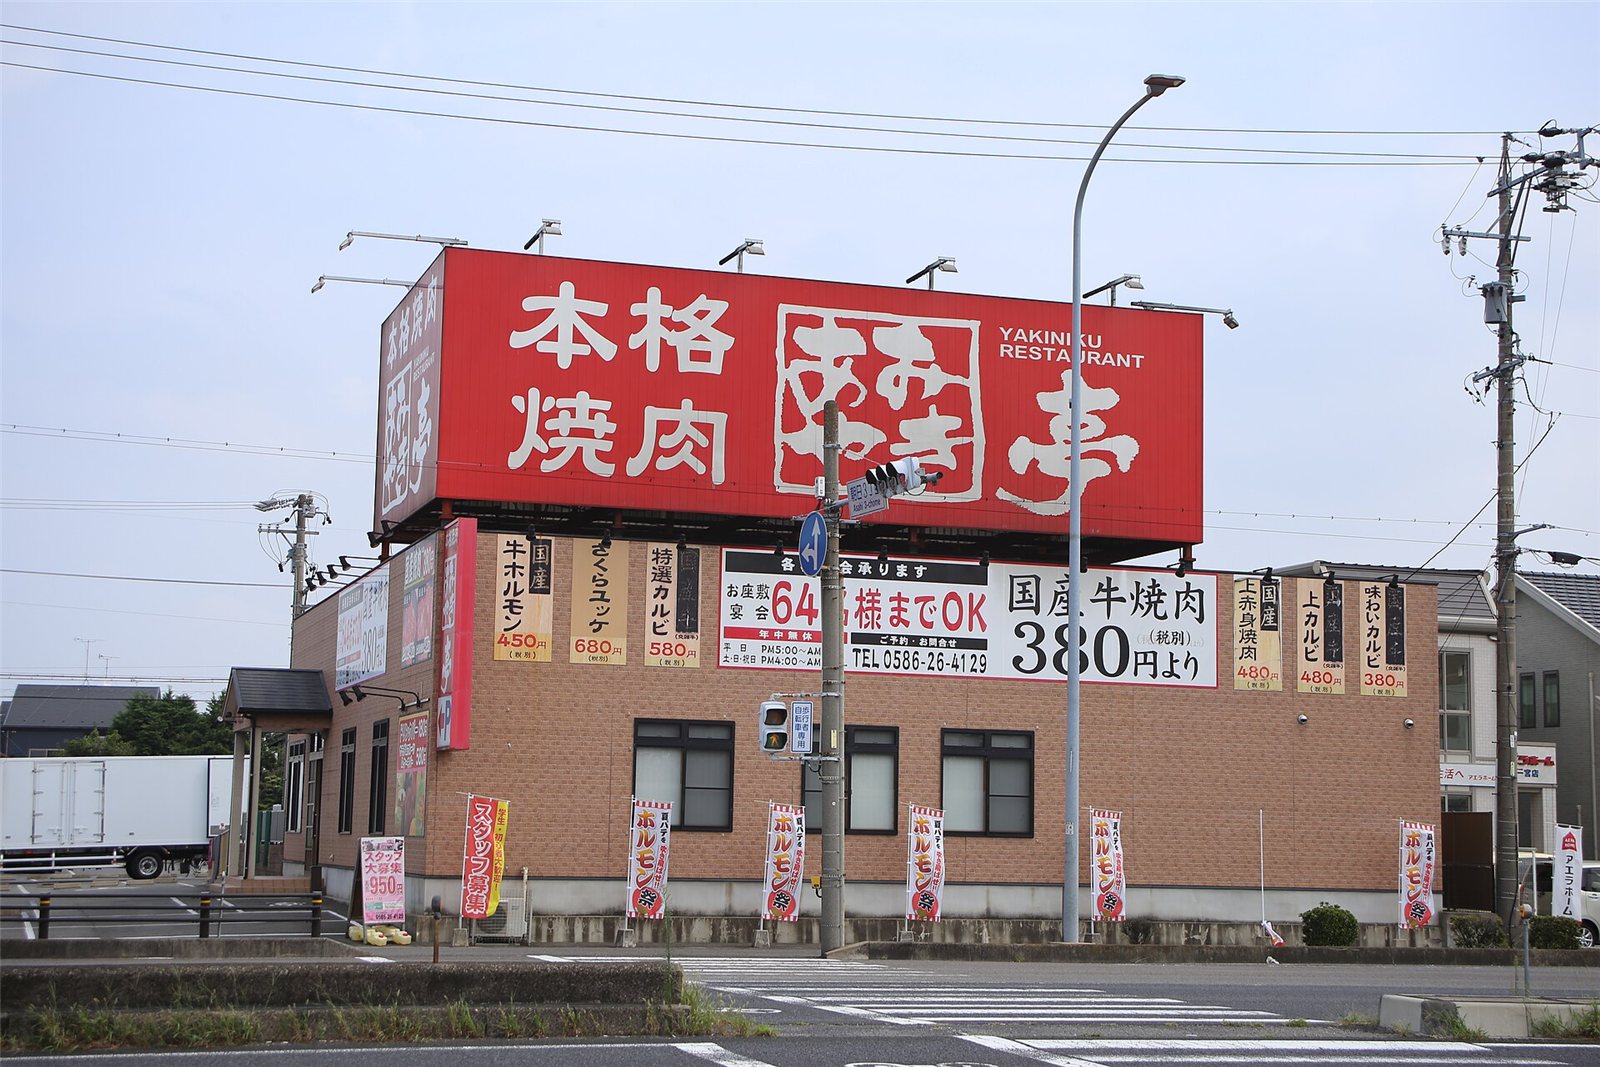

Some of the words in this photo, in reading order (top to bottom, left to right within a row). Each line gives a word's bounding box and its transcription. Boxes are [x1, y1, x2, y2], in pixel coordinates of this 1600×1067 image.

[509, 281, 735, 375] 本格
[508, 387, 728, 485] 焼肉
[995, 368, 1139, 517] 亭
[503, 540, 526, 632] 牛ホルモン
[530, 544, 549, 589] 国産
[589, 542, 611, 633] さくらユッケ
[651, 547, 673, 636] 特選カルビ
[727, 583, 770, 600] お座敷
[781, 557, 928, 578] 各会承ります
[730, 603, 769, 620] 宴会
[771, 581, 987, 633] 64様までOK
[1008, 574, 1205, 624] 国産牛焼肉
[1239, 578, 1258, 661] 上赤身焼肉
[1261, 585, 1277, 627] 国産
[497, 633, 546, 649] 450円
[575, 639, 622, 655] 680円
[649, 642, 696, 658] 580円
[759, 630, 813, 640] 年中無休
[880, 636, 957, 648] ご予約・お問合せ
[1150, 629, 1190, 647] (税別)
[1302, 590, 1320, 662] 上カルビ
[1364, 585, 1381, 668] 味わいカルビ
[852, 648, 879, 669] TEL
[883, 650, 987, 673] 0586-26-4129
[1237, 666, 1278, 681] 480円
[1301, 671, 1341, 685] 480円
[1364, 673, 1404, 688] 380円
[365, 851, 402, 861] スタッフ
[365, 863, 402, 874] 大募集
[465, 803, 492, 914] スタッフ募集
[636, 809, 656, 889] ホルモン
[771, 814, 792, 892] ホルモン
[914, 816, 931, 892] ホルモン
[1095, 821, 1114, 894] ホルモン
[1405, 831, 1422, 902] ホルモン
[1563, 855, 1574, 915] アエラホーム
